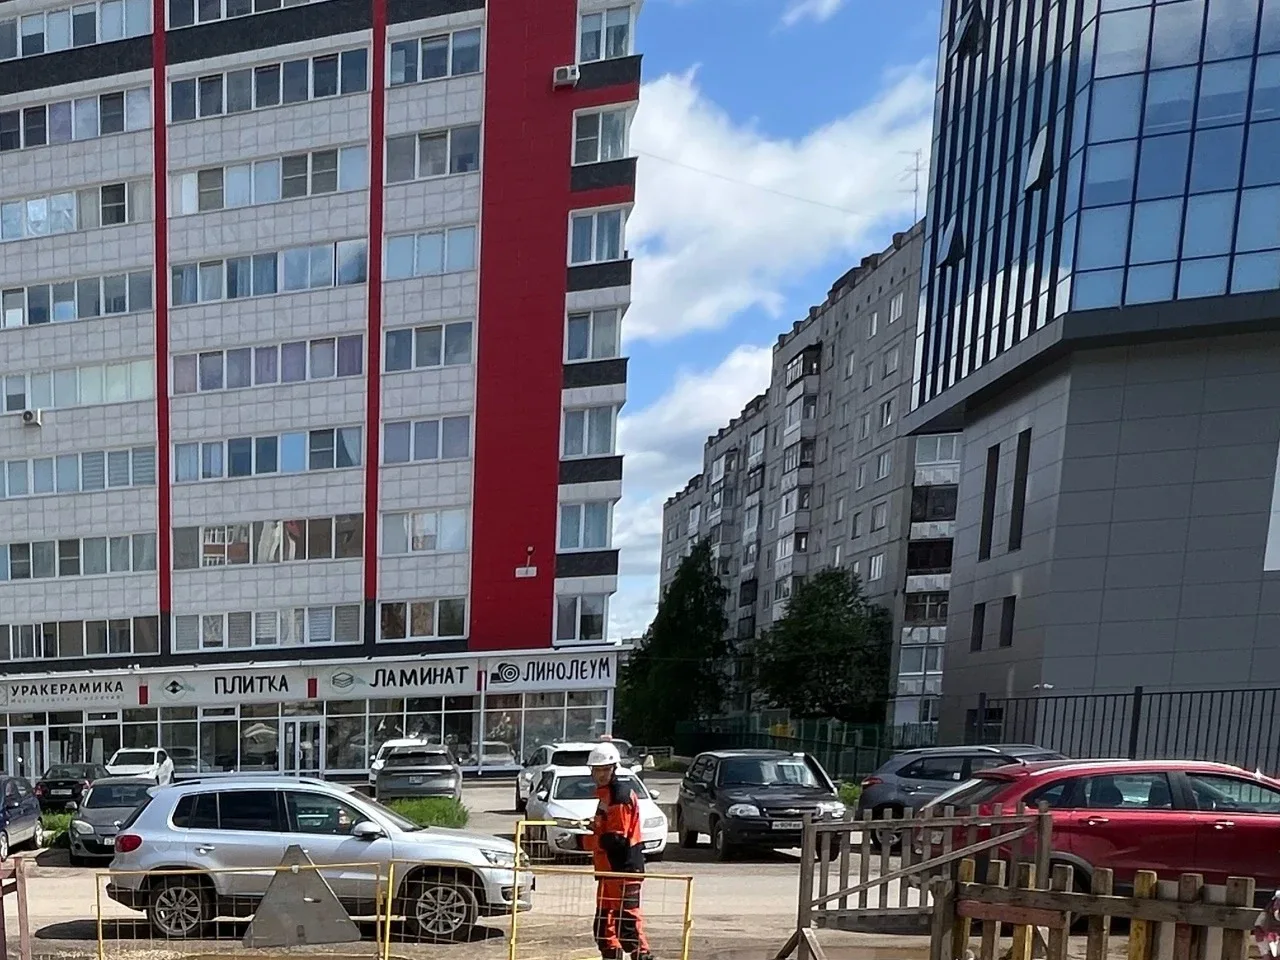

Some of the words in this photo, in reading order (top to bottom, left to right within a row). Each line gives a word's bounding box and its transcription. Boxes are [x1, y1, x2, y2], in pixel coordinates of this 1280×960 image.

[369, 666, 470, 687] ЛАМИНАТ
[522, 657, 611, 681] ЛИНОЛЕУМ
[11, 681, 124, 697] УРАКЕРАМИКА
[214, 675, 289, 694] ПЛИТКА
